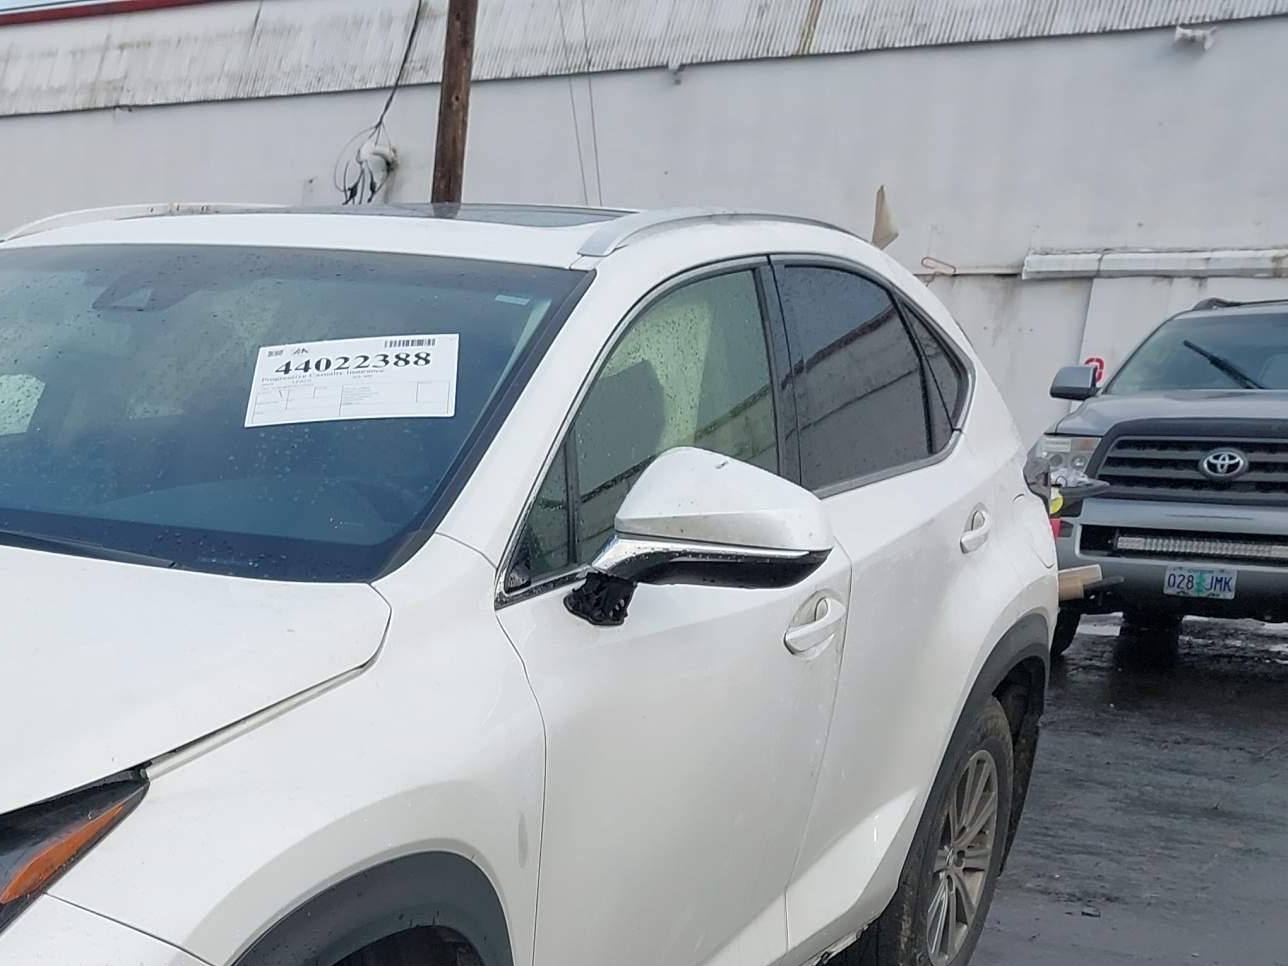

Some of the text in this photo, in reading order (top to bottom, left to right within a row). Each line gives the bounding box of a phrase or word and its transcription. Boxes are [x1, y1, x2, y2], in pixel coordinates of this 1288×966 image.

[274, 351, 432, 376] 44022388
[1167, 572, 1233, 593] 028 JMK
